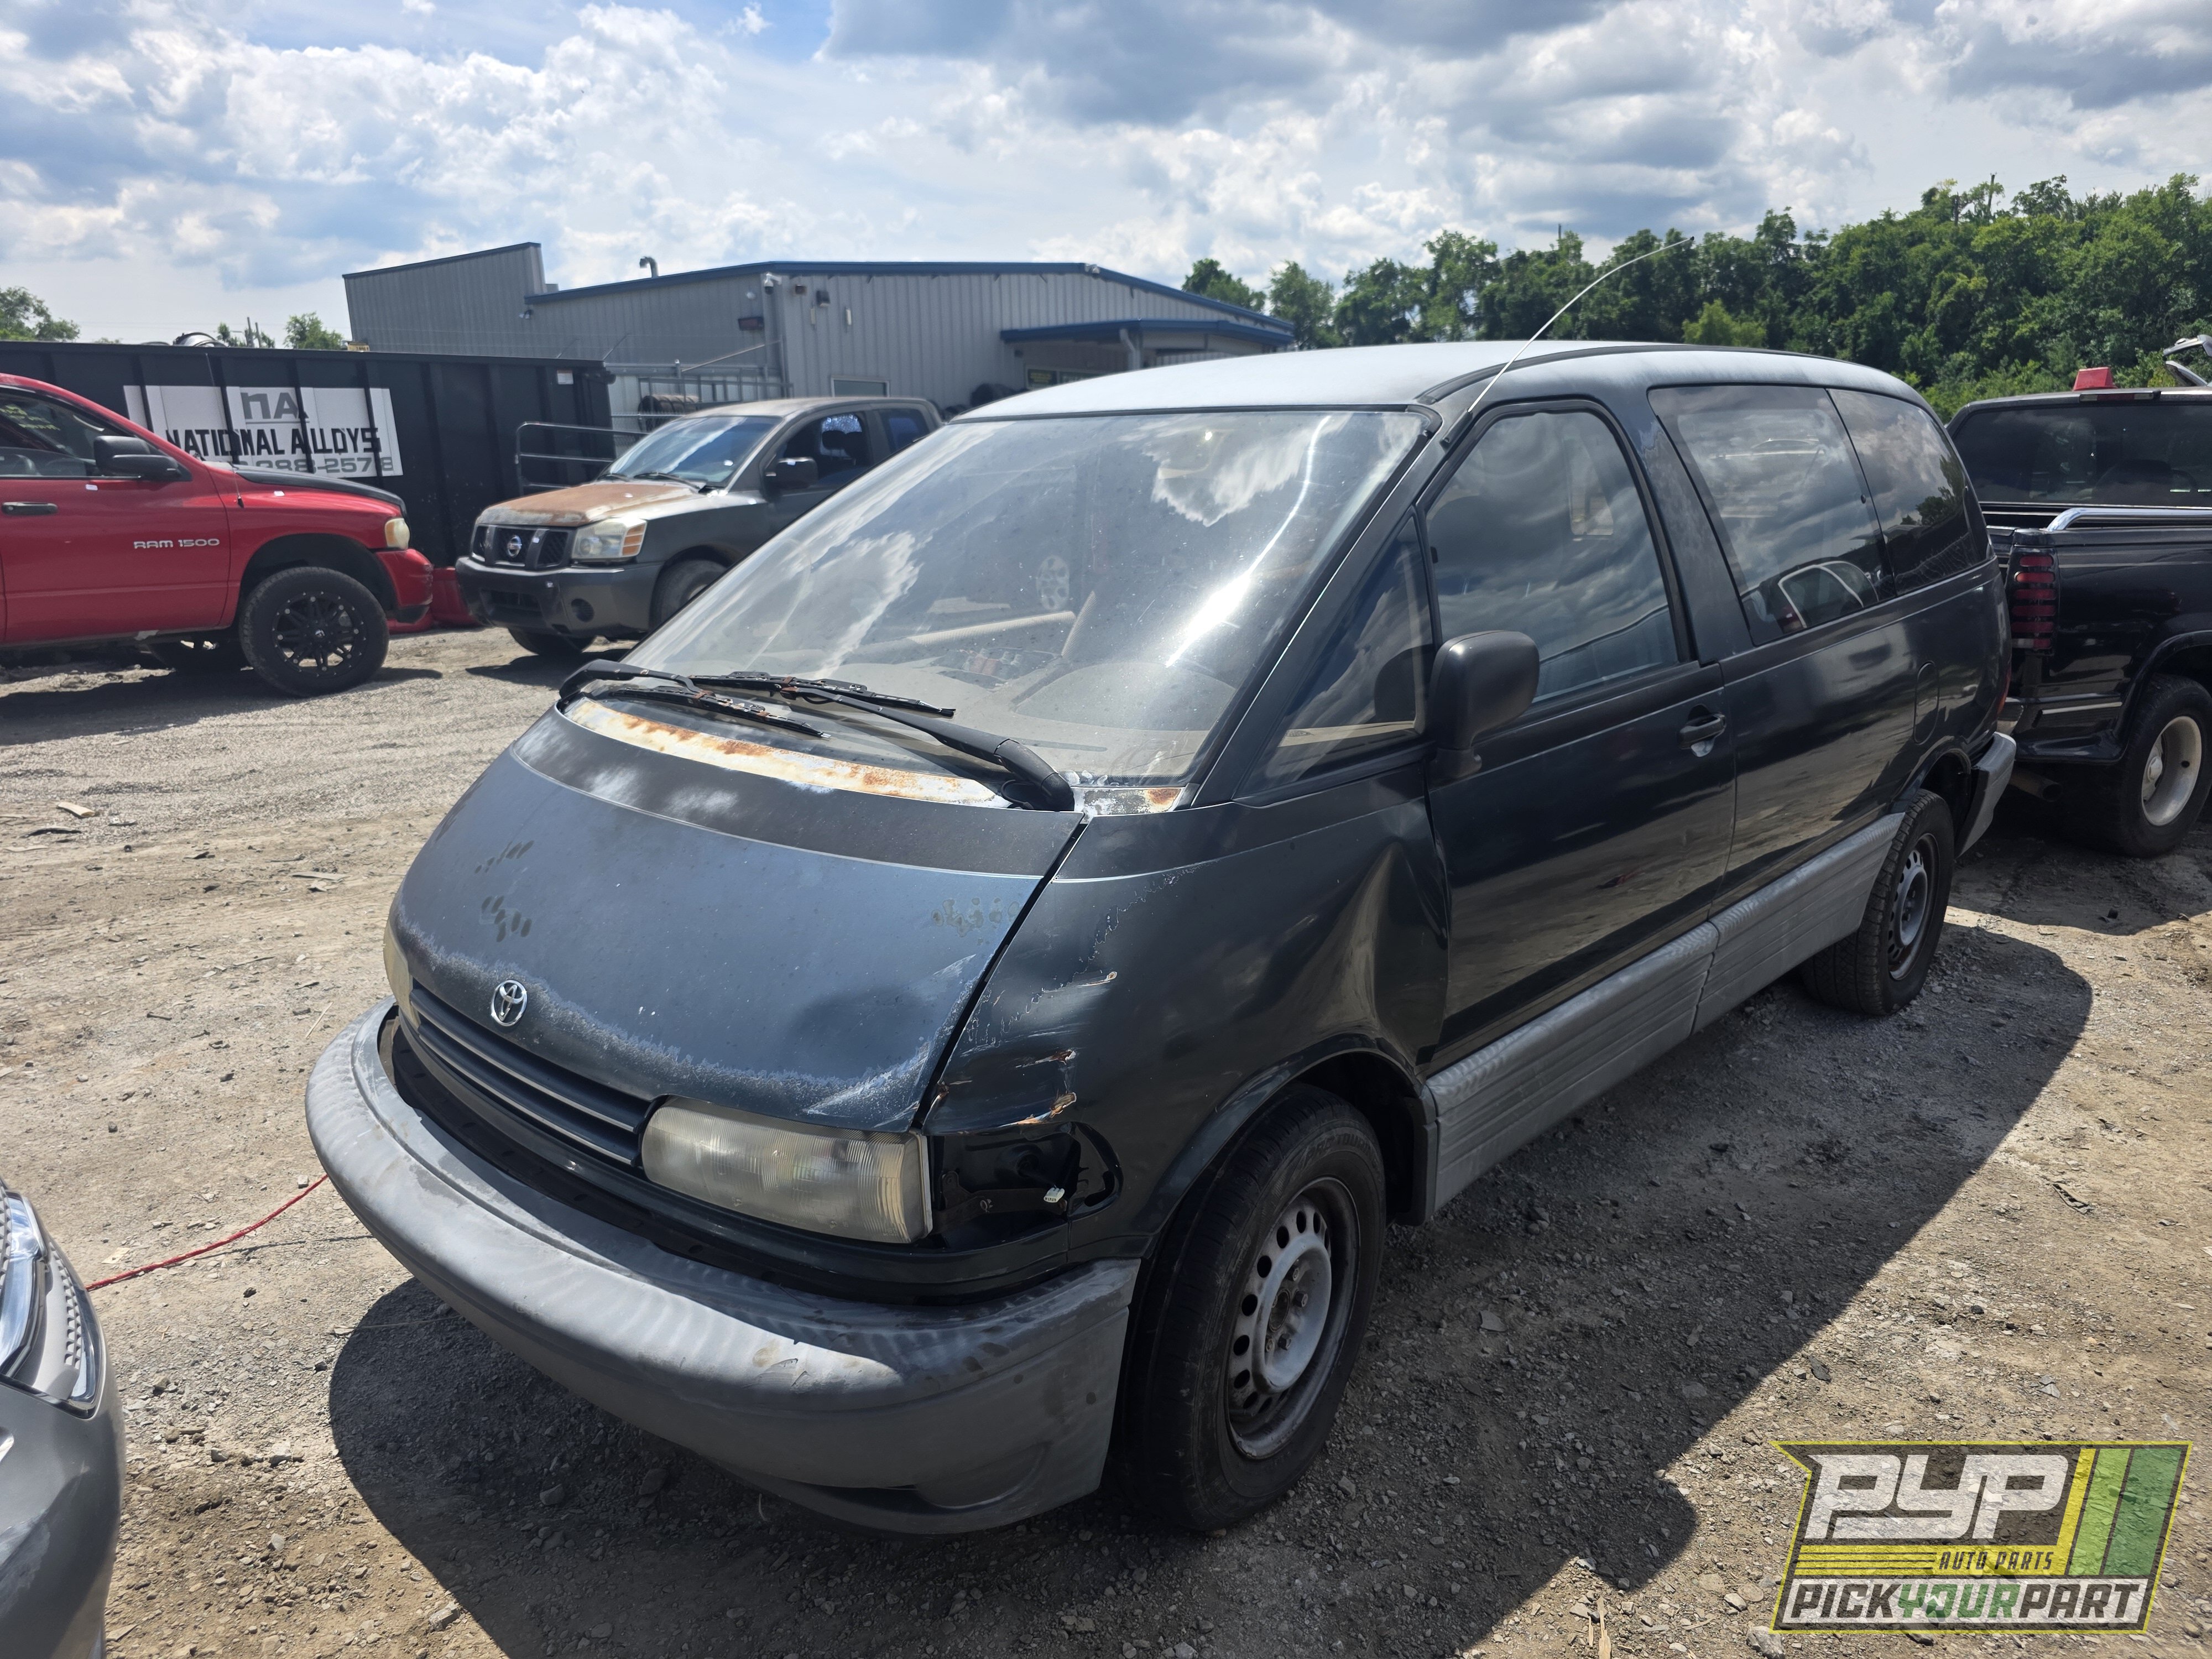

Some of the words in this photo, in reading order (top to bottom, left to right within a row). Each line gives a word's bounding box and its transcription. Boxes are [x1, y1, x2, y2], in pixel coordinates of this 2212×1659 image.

[166, 429, 285, 461] NATIONAL
[291, 427, 382, 455] ALLOYS
[134, 540, 173, 549] RAM
[178, 538, 220, 547] 1500
